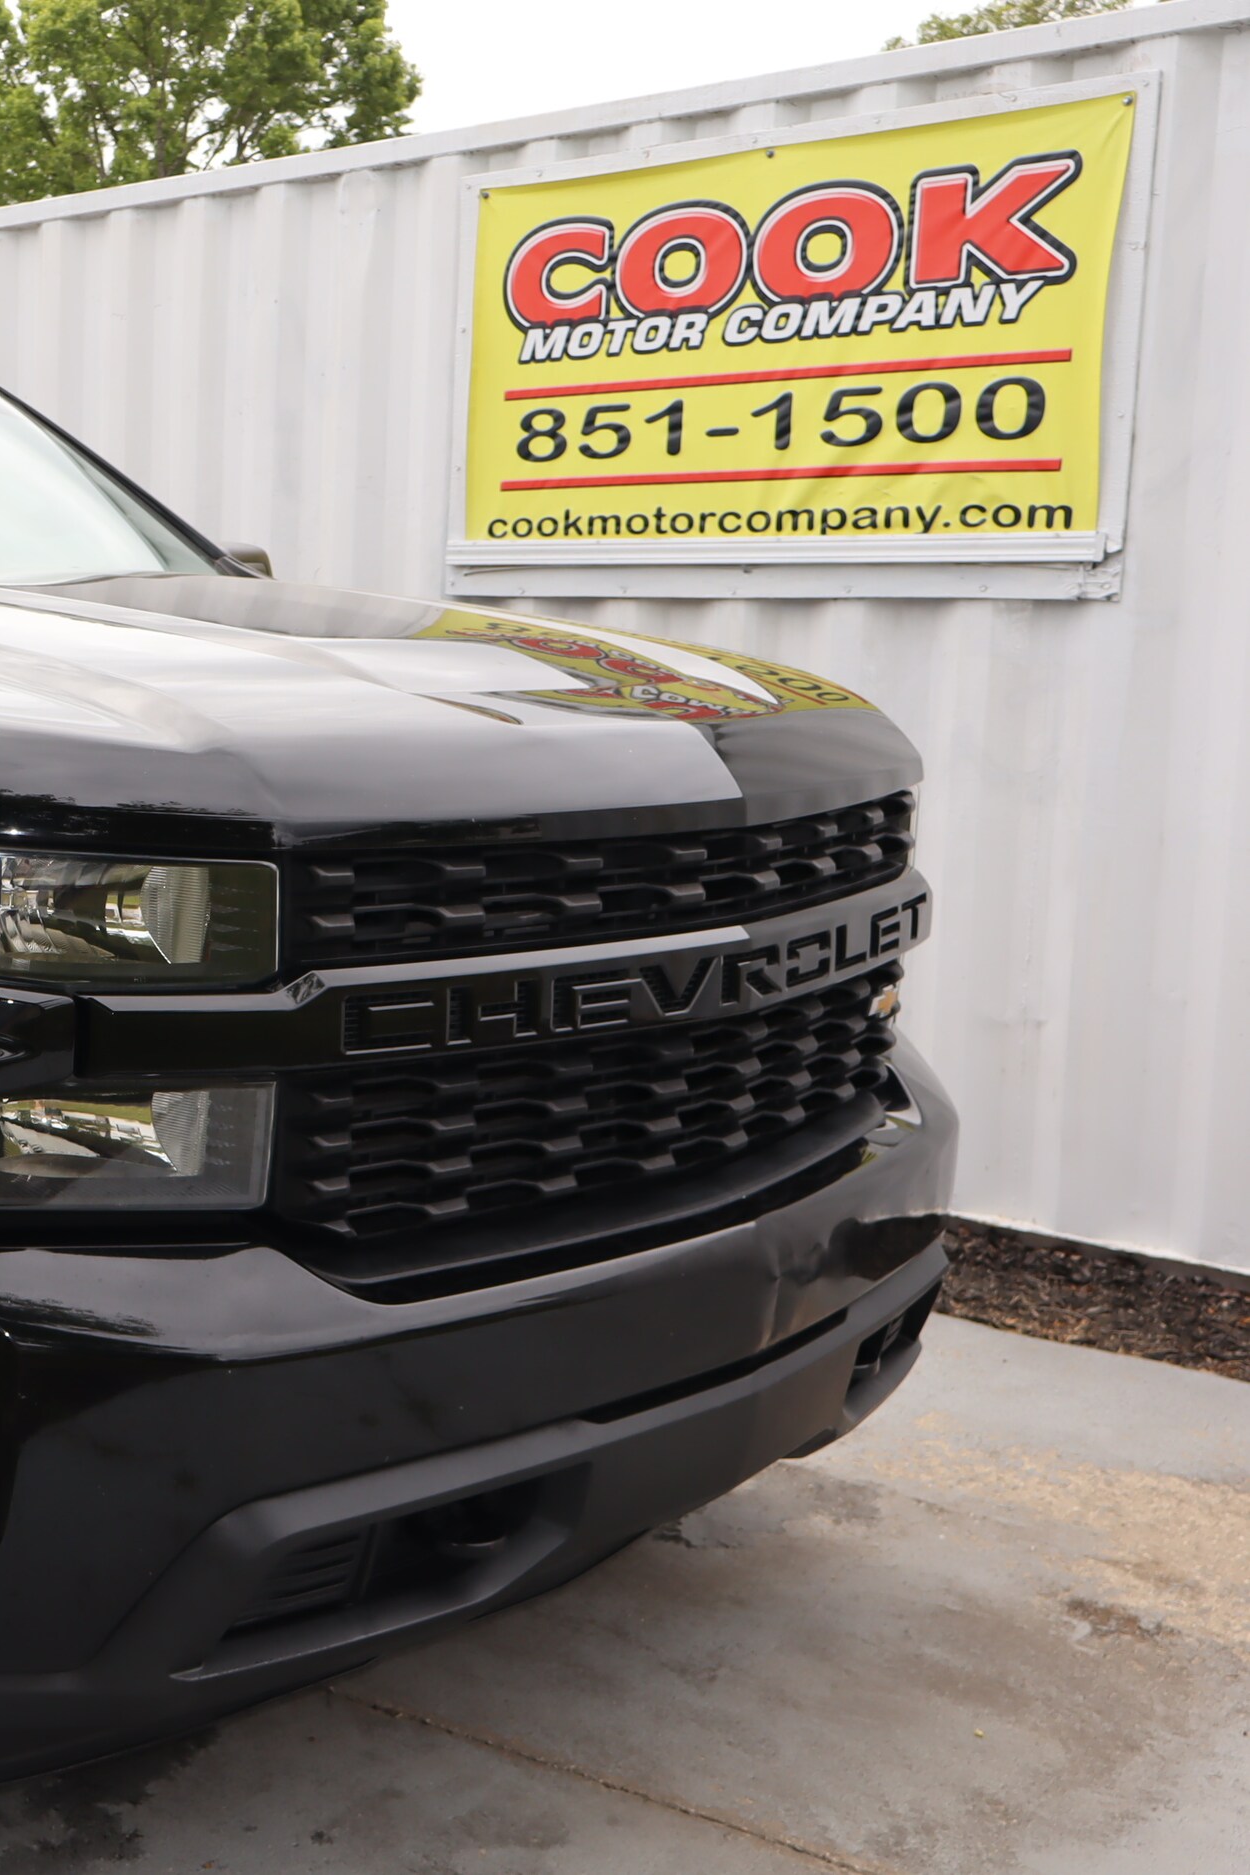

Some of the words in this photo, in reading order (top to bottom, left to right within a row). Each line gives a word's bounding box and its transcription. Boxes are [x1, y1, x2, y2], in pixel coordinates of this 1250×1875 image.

[504, 149, 1083, 329] COOK
[519, 313, 708, 364] MOTOR
[723, 279, 1045, 344] COMPANY
[515, 376, 1047, 463] 851-1500
[487, 502, 1074, 540] cookmotorcompany.com
[342, 893, 927, 1056] CHEVROLET
